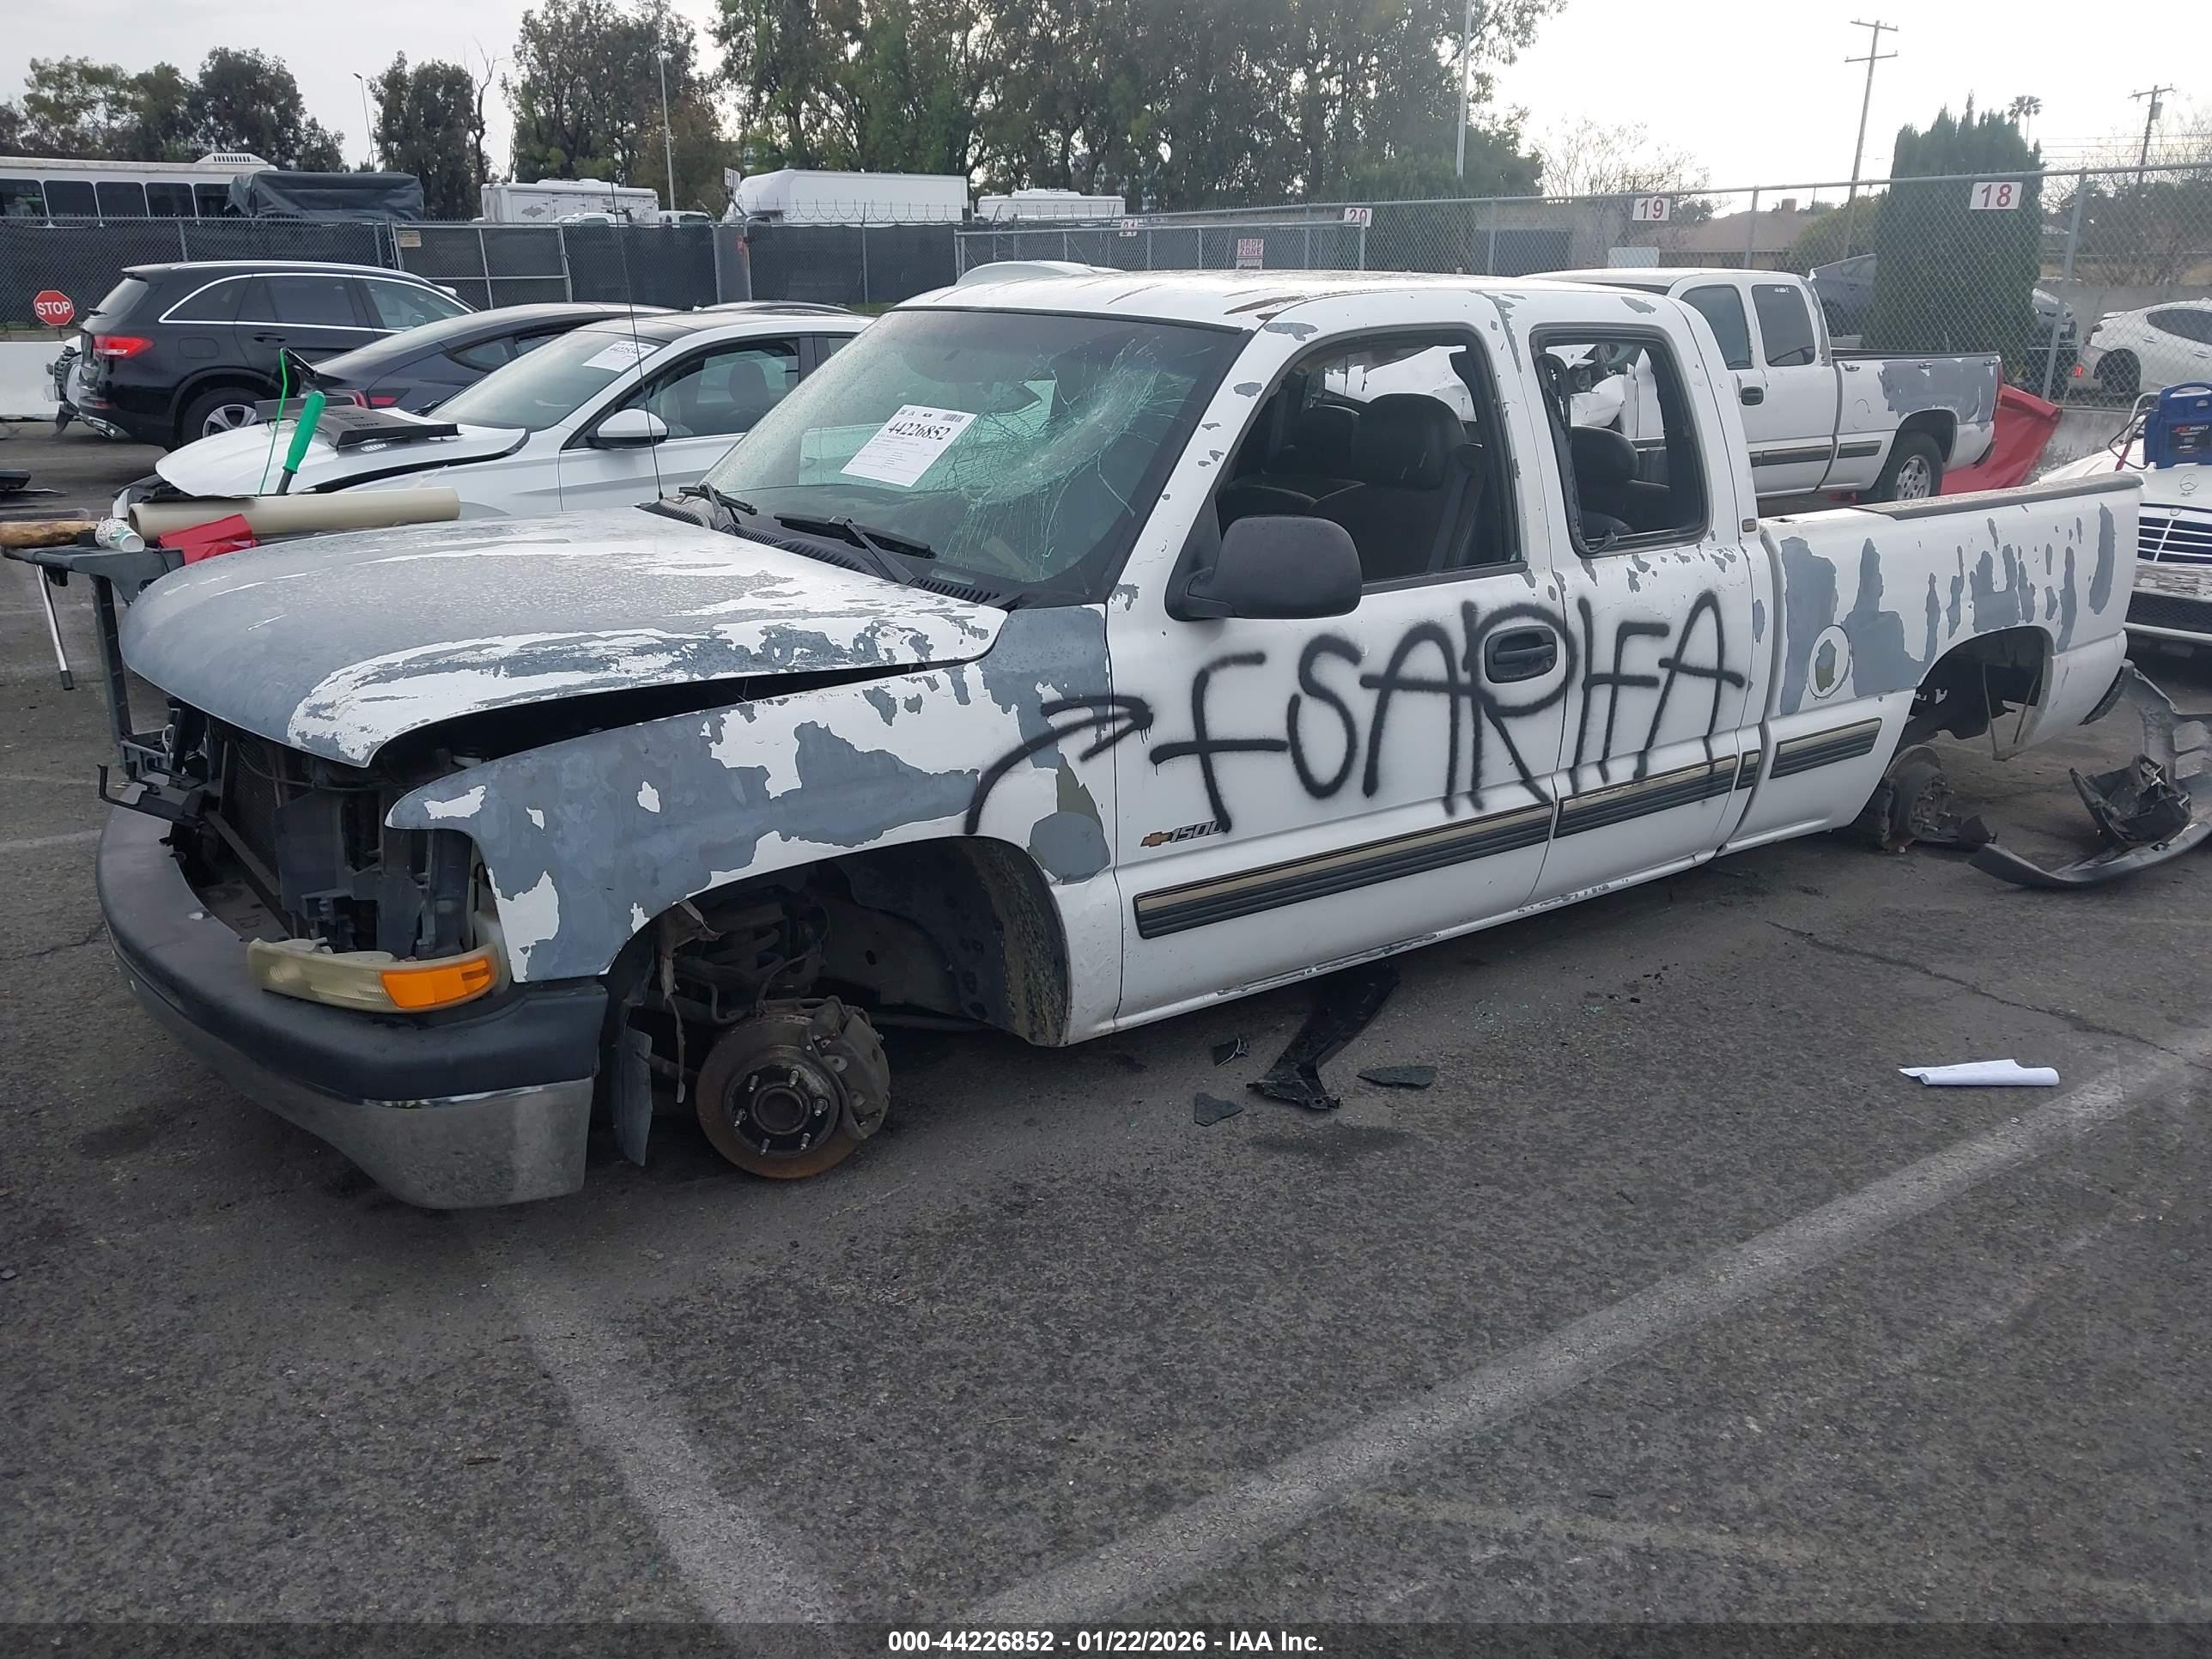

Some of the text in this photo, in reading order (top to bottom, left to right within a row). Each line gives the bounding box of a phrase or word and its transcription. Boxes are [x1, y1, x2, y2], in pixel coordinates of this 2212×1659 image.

[1981, 184, 2013, 208] 18
[1349, 209, 1368, 224] 20
[1640, 198, 1664, 219] 19
[36, 301, 71, 316] STOP
[887, 421, 952, 441] 44226852
